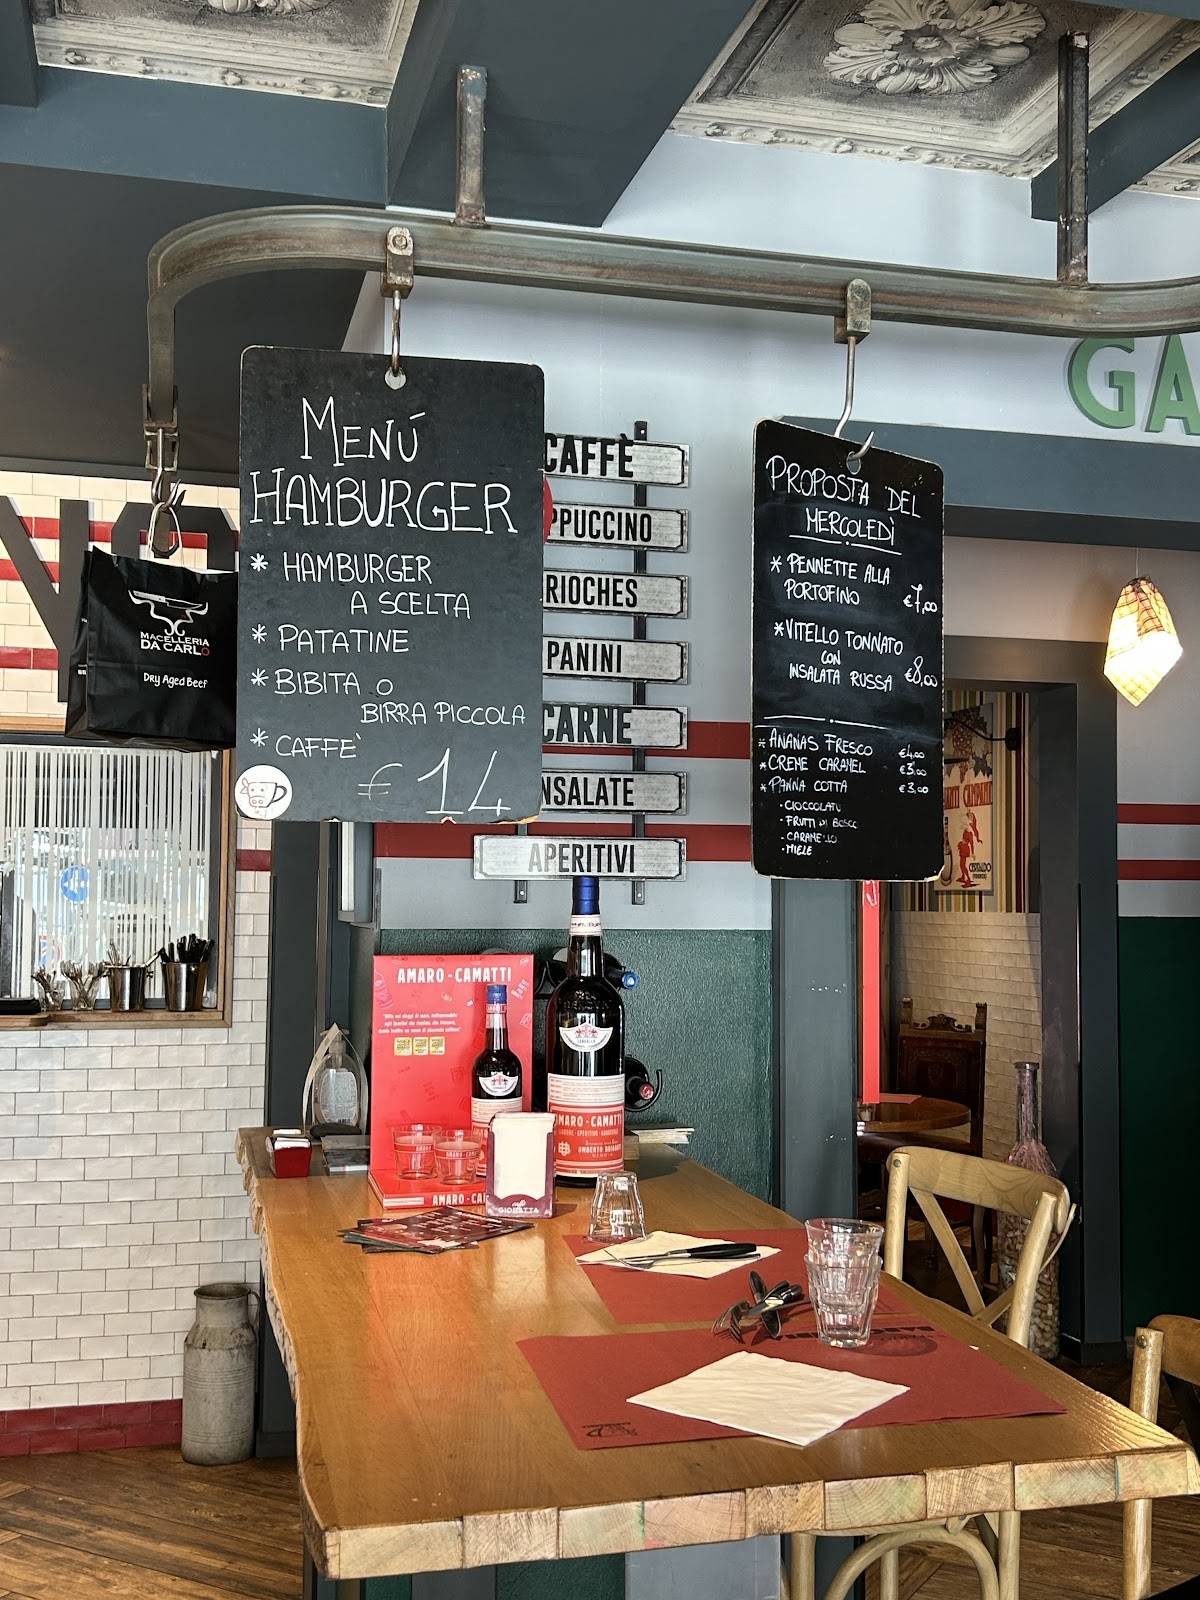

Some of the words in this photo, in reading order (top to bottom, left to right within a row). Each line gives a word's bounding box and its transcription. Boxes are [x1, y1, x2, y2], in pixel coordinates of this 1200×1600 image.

[543, 432, 634, 478] CAFFÈ
[766, 455, 869, 506] PROPOSTA
[884, 486, 921, 518] DEL
[250, 468, 518, 534] HAMBURGER
[805, 507, 895, 546] MERCOLEDÌ
[283, 552, 433, 584] HAMBURGER
[786, 553, 858, 580] PENNETTE
[864, 564, 890, 585] ALLA
[350, 591, 367, 615] A
[378, 592, 471, 619] SCELTA
[784, 578, 860, 605] PORTOFINO
[140, 631, 210, 647] MACELLERIA
[141, 639, 161, 650] DA
[163, 643, 210, 656] CARLO
[278, 624, 409, 653] PATATINE
[785, 618, 840, 646] VITELLO
[845, 631, 904, 656] TONNATO
[547, 641, 622, 673] PANINI
[820, 650, 841, 665] CON
[162, 674, 185, 688] Aged
[186, 677, 208, 688] Beef
[275, 669, 360, 695] BIBITA
[789, 663, 841, 685] INSALATA
[850, 671, 893, 692] RUSSA
[360, 702, 426, 725] BIRRA
[434, 702, 525, 725] PICCOLA
[542, 704, 632, 744] CARNE
[769, 728, 819, 751] ANANAS
[824, 734, 873, 756] FRESCO
[768, 754, 808, 771] CREME
[819, 757, 866, 773] CARAMEL
[417, 748, 511, 817] 14
[768, 776, 806, 793] PANNA
[814, 780, 847, 793] COTTA
[785, 815, 816, 828] FRUTTI
[528, 843, 635, 873] APERITIVI
[786, 844, 812, 855] MIELE
[397, 967, 444, 983] AMARO
[454, 967, 512, 983] CAMATTI
[432, 1193, 464, 1206] AMARO
